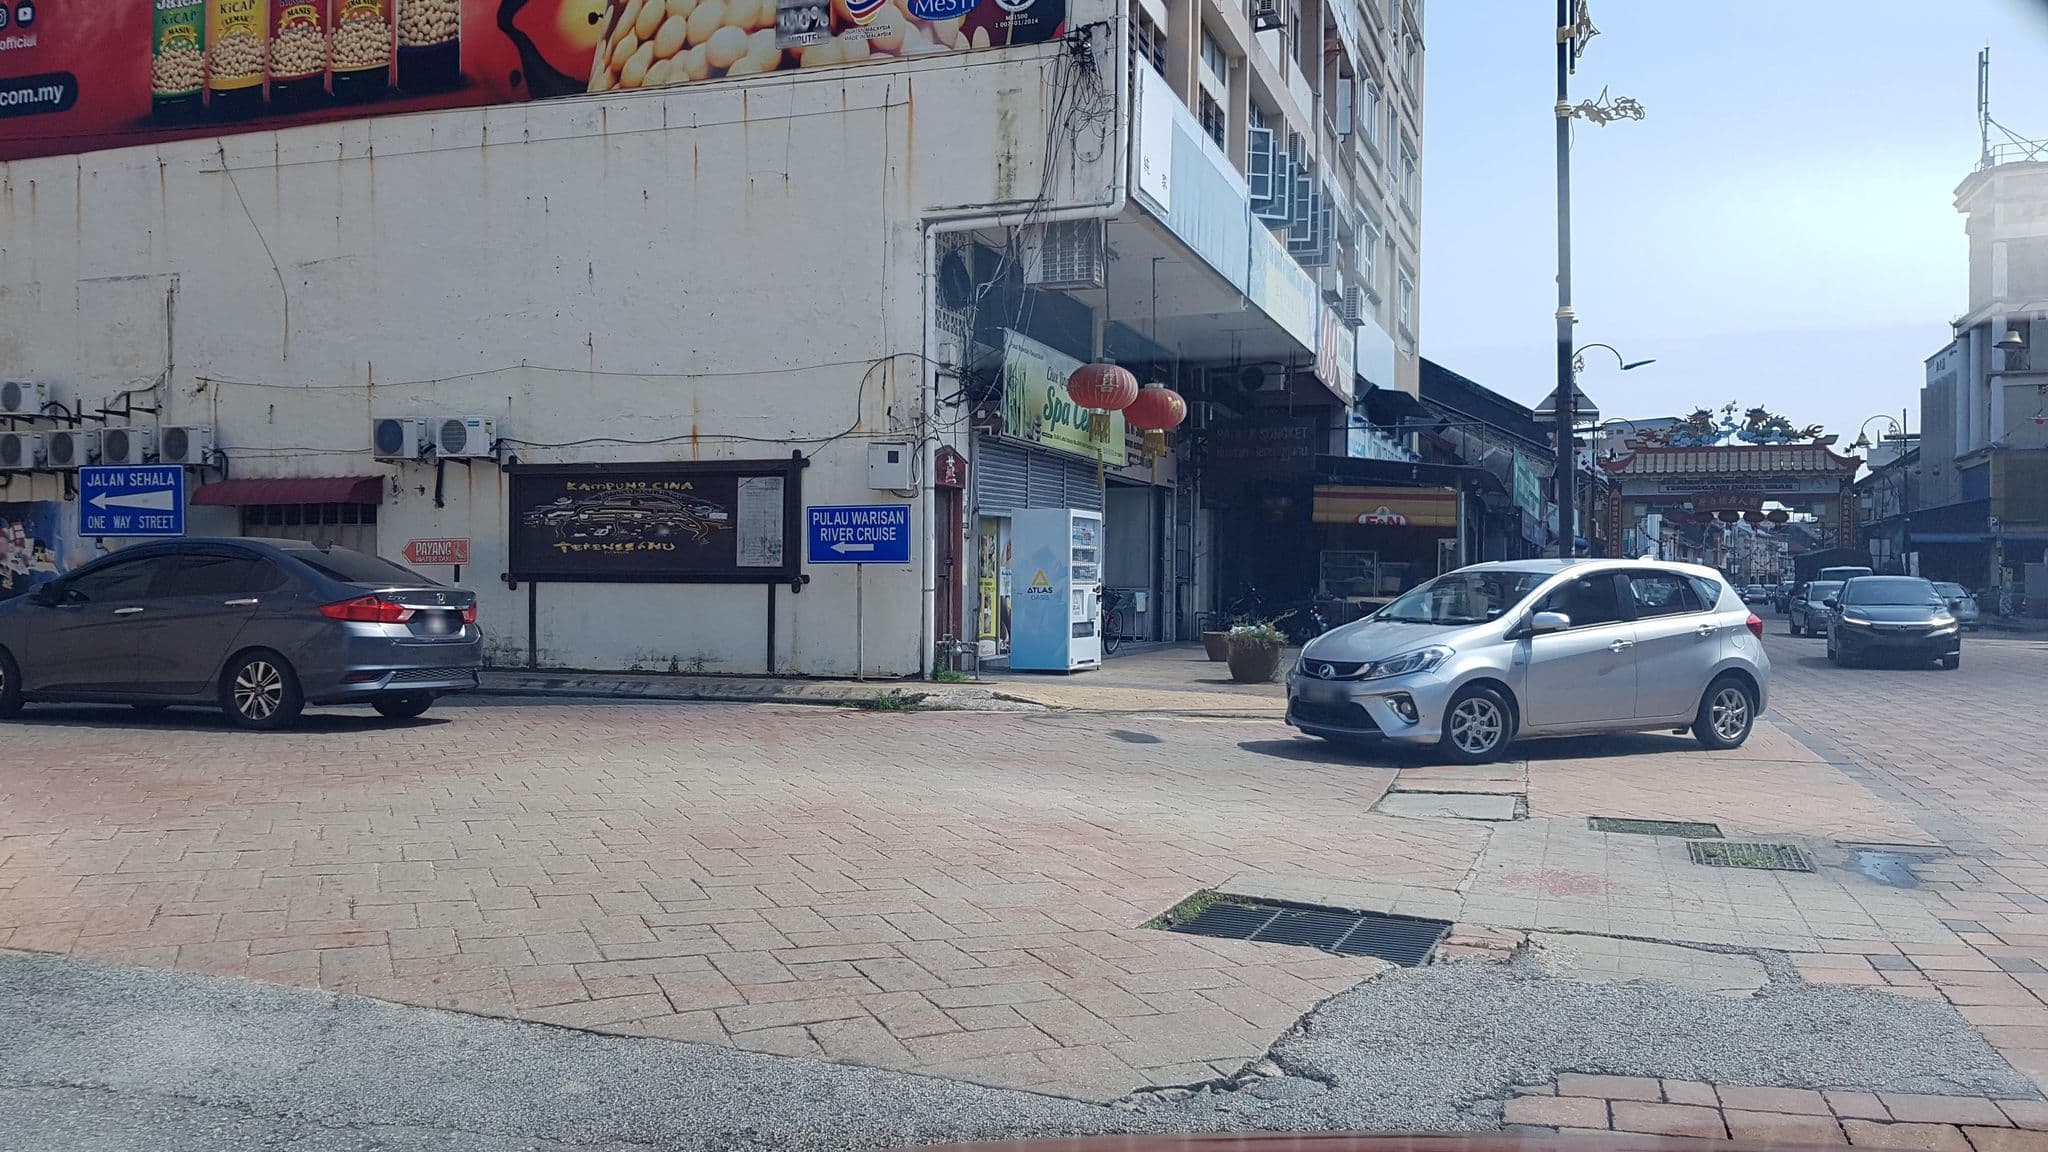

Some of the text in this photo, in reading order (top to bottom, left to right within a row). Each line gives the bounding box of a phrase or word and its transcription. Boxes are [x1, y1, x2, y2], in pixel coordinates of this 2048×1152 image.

[287, 8, 311, 17] MANIS
[0, 34, 37, 50] official
[1043, 385, 1071, 432] Spa
[87, 472, 175, 487] JALAN SEHALA
[652, 481, 694, 490] CINA
[88, 515, 175, 529] ONE WAY STREET
[813, 511, 905, 526] PULAU WARISAN
[820, 527, 897, 542] RIVER CRUISE
[415, 541, 452, 556] PAYANG
